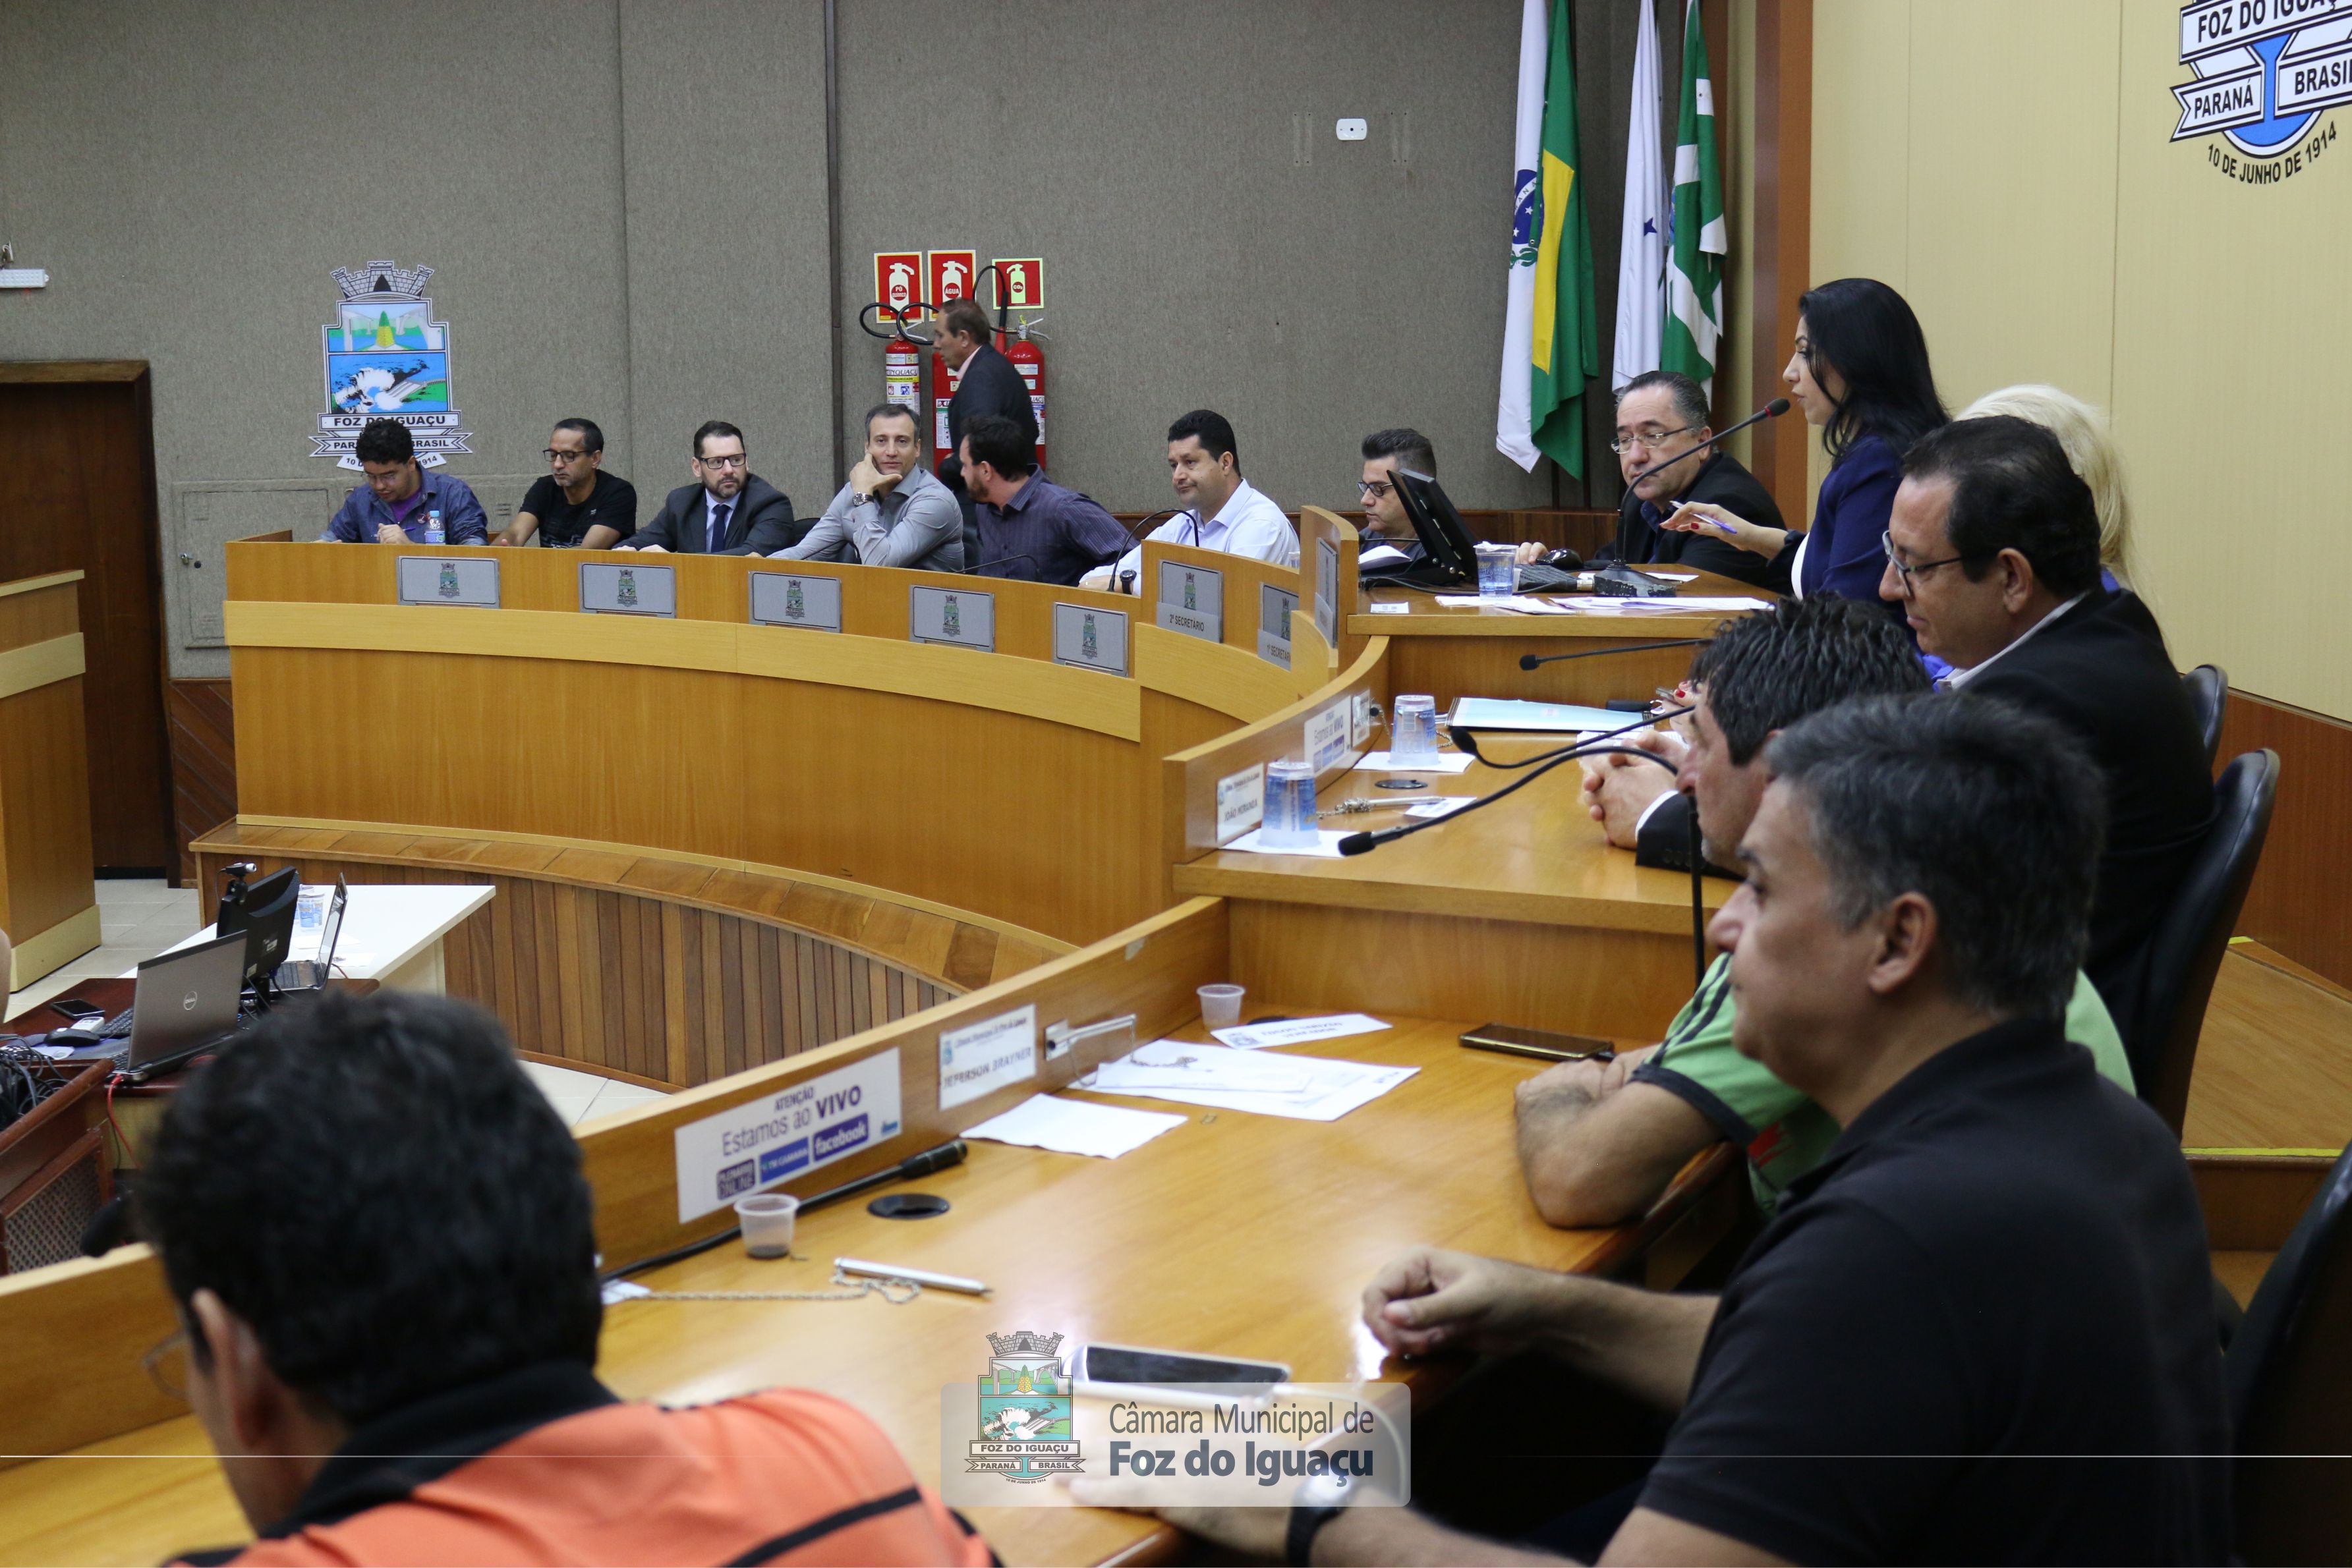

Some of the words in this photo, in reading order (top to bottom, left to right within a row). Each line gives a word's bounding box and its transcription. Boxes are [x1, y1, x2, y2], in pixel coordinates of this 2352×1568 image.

[2198, 7, 2233, 43] FOZ
[2240, 0, 2266, 30] DO
[2194, 78, 2253, 119] PARANÁ
[2208, 144, 2220, 167] 10
[2222, 154, 2237, 179] DE
[2240, 162, 2281, 184] JUNHO
[2285, 152, 2301, 178] DE
[2305, 121, 2337, 163] 1914
[334, 418, 361, 426] FOZ
[774, 1086, 815, 1111] ATENÇÃO
[722, 1117, 788, 1156] Estamos
[793, 1107, 811, 1129] ao
[816, 1084, 861, 1119] VIVO
[815, 1120, 867, 1154] facebook
